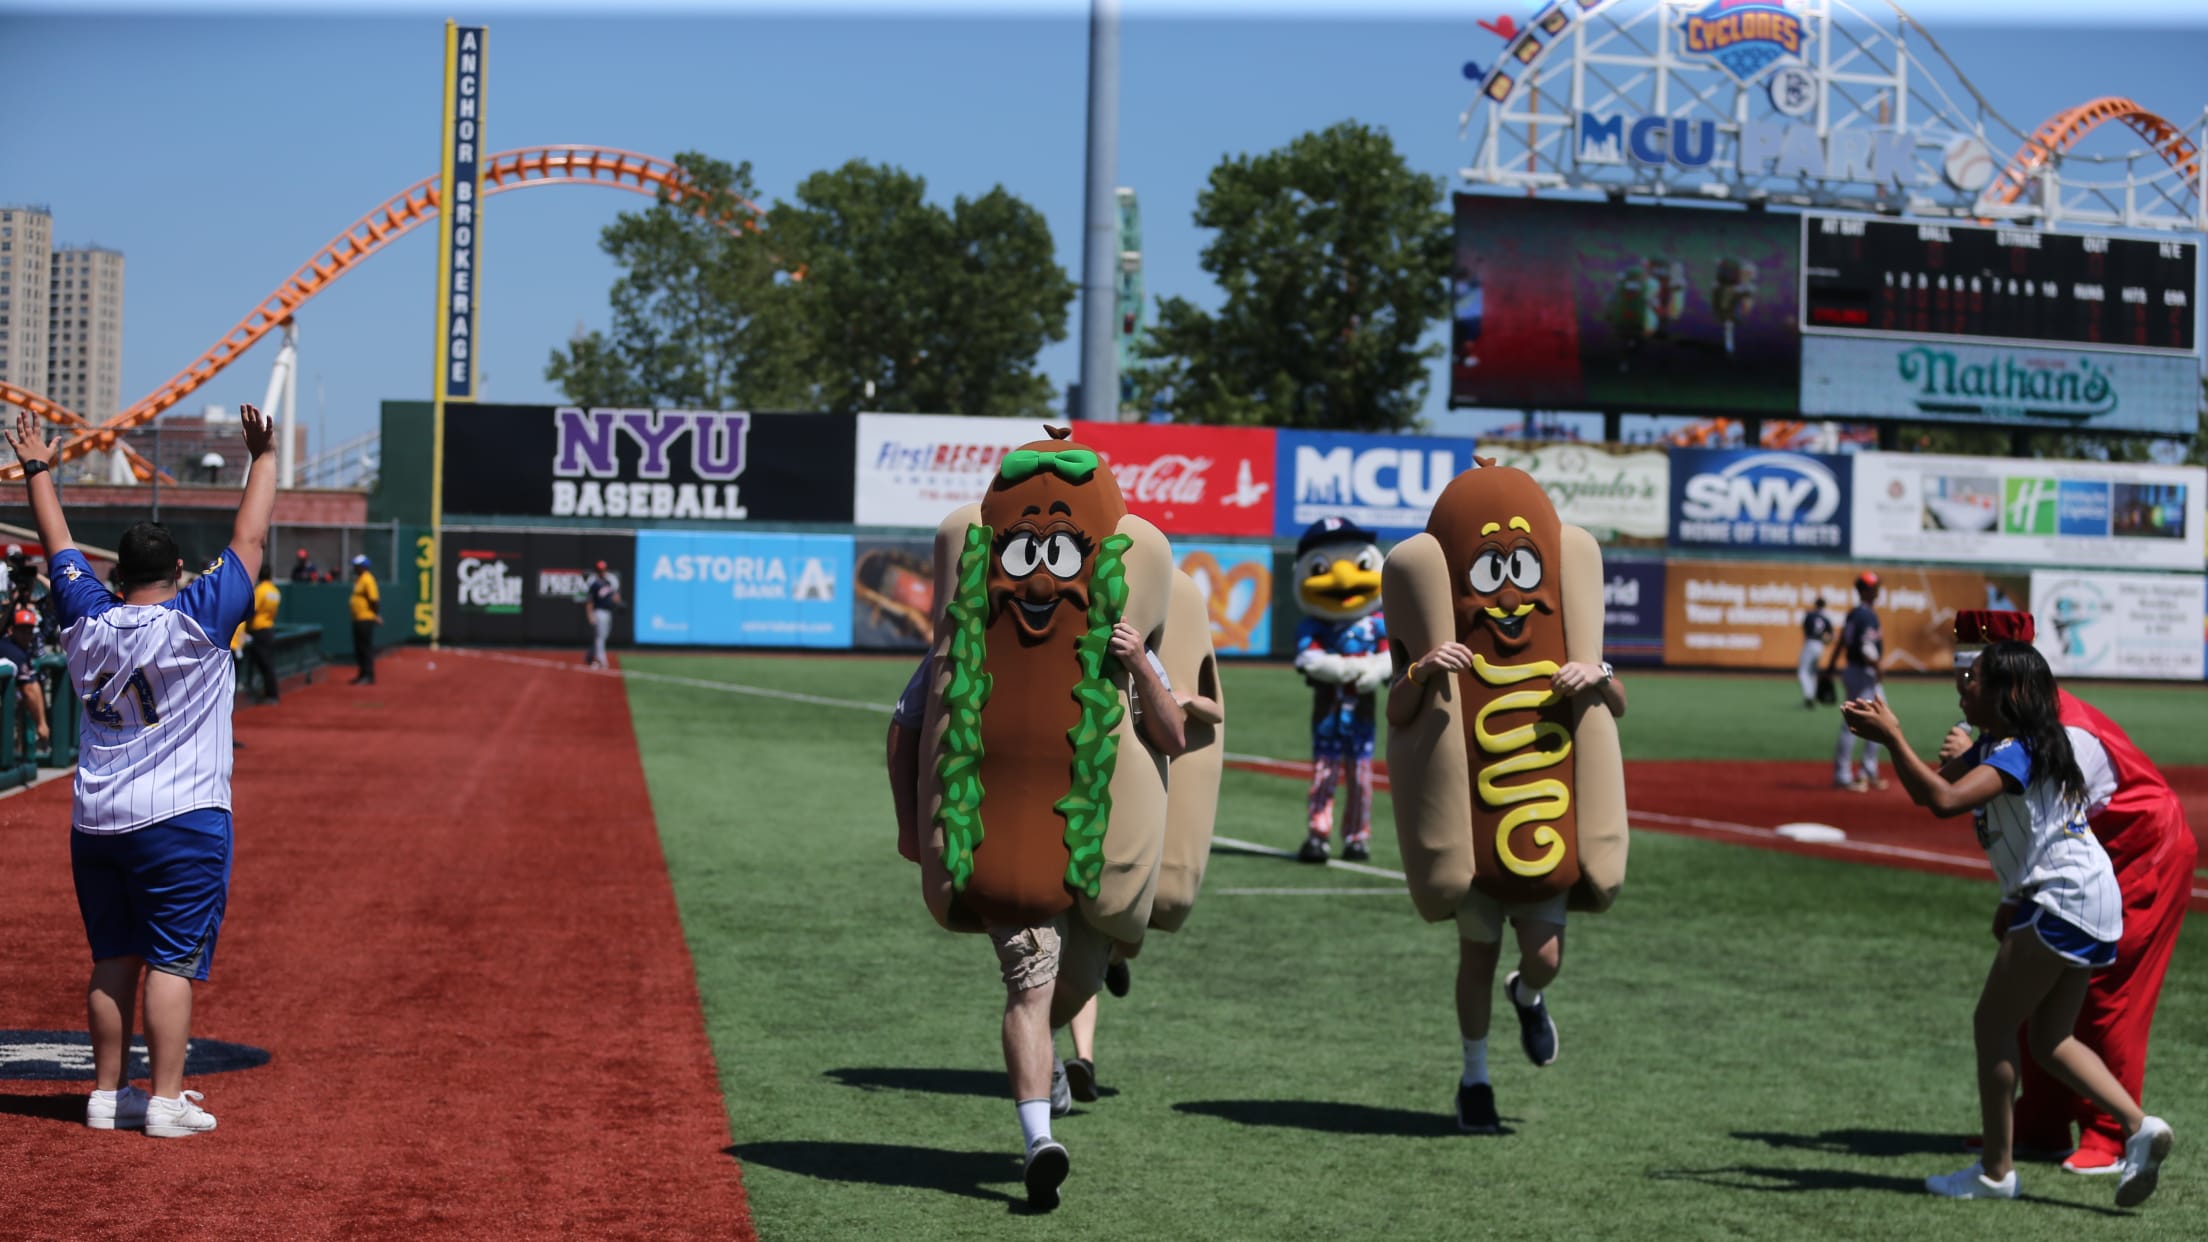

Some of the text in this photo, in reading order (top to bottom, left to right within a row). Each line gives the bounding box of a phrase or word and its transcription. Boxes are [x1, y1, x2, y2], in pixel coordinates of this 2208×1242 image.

[1687, 12, 1799, 54] CYCLONES
[1578, 111, 1918, 186] MCU PARK
[451, 31, 478, 383] ANCHOR BROKERAGE
[1898, 347, 2111, 402] Nathan's
[553, 407, 750, 480] NYU
[1294, 445, 1455, 508] MCU
[1681, 472, 1815, 522] SNY
[552, 481, 747, 520] BASEBALL
[414, 536, 434, 635] 315
[457, 557, 508, 586] Get
[652, 555, 787, 582] ASTORIA
[733, 583, 786, 600] BANK
[1604, 576, 1640, 606] rid
[1685, 579, 1745, 607] Driving
